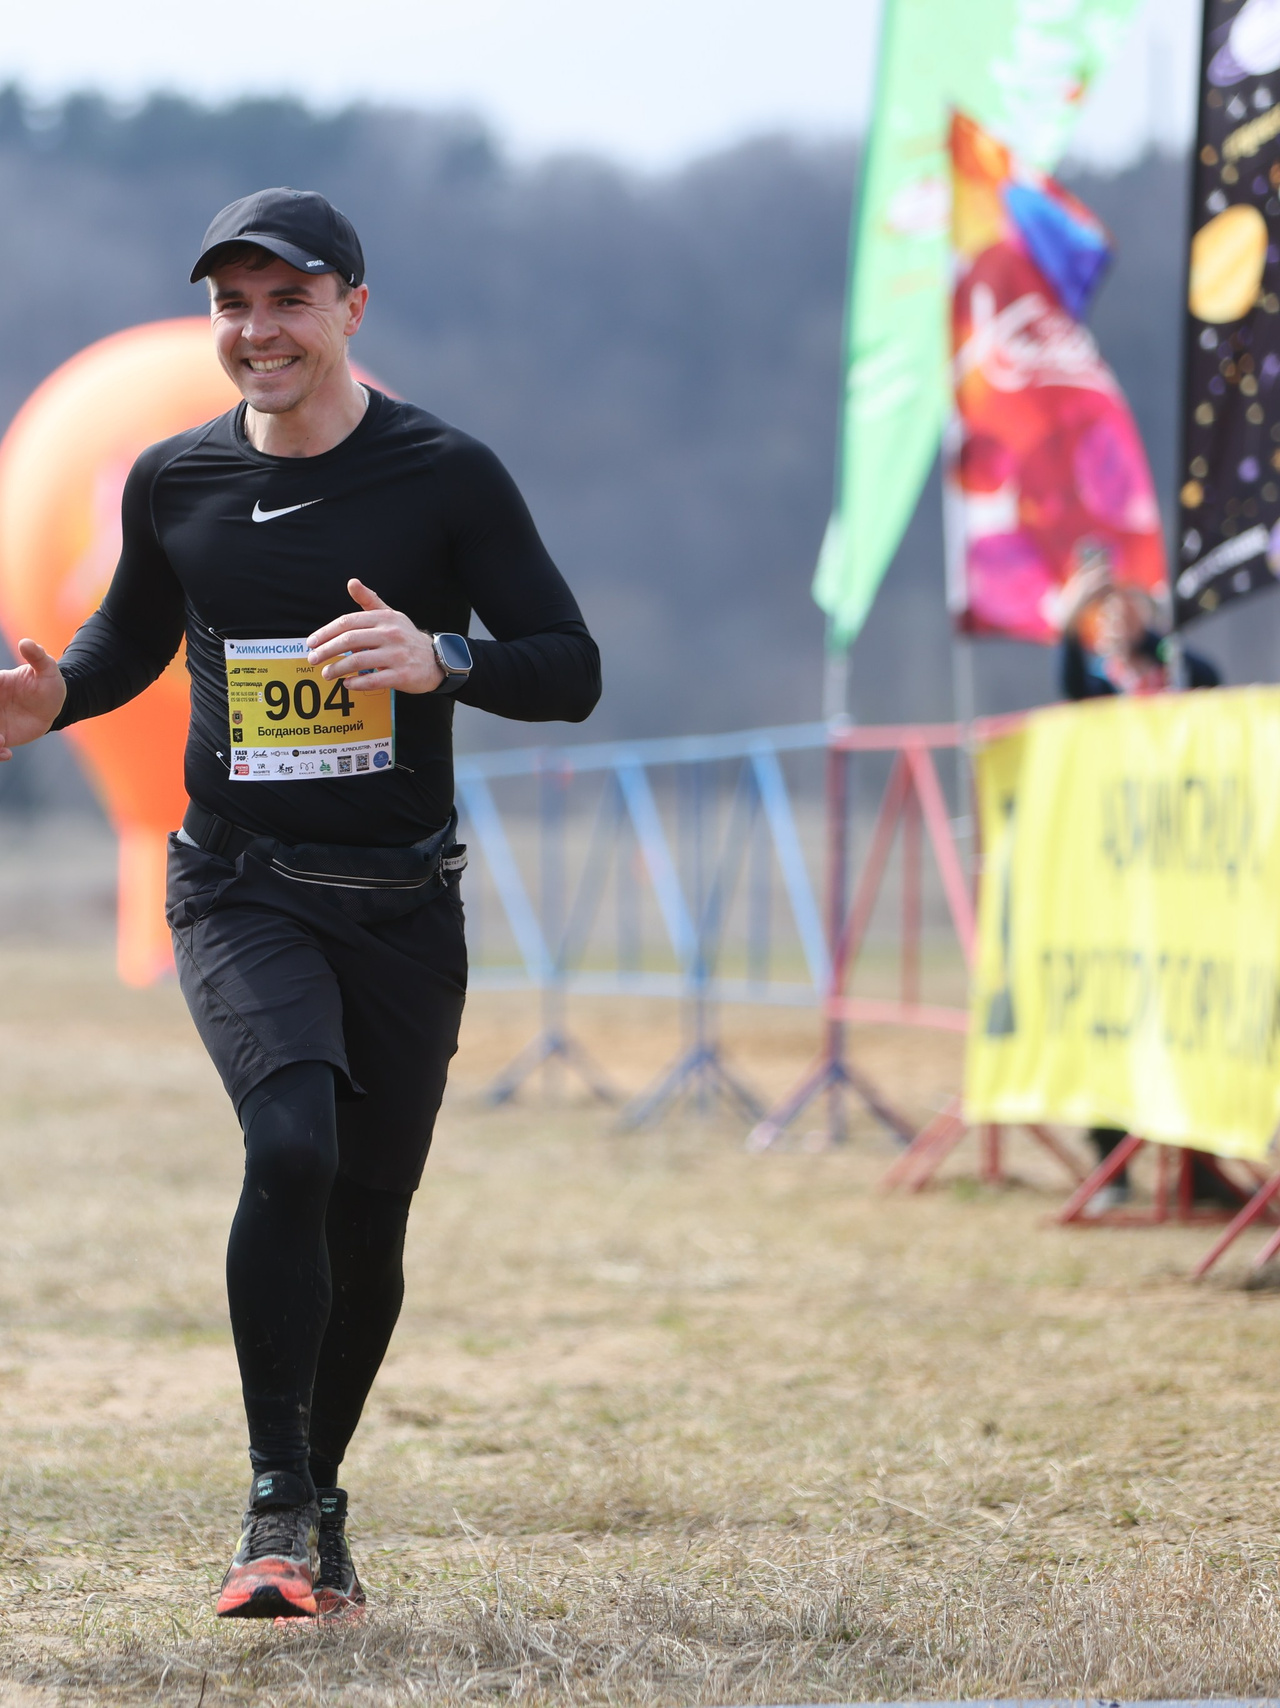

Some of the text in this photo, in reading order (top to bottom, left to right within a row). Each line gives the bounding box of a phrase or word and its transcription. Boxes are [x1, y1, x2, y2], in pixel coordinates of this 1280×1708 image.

[236, 643, 304, 654] ХИМКИНСКИЙ
[264, 677, 354, 721] 904
[258, 720, 364, 738] Богданов Валерий
